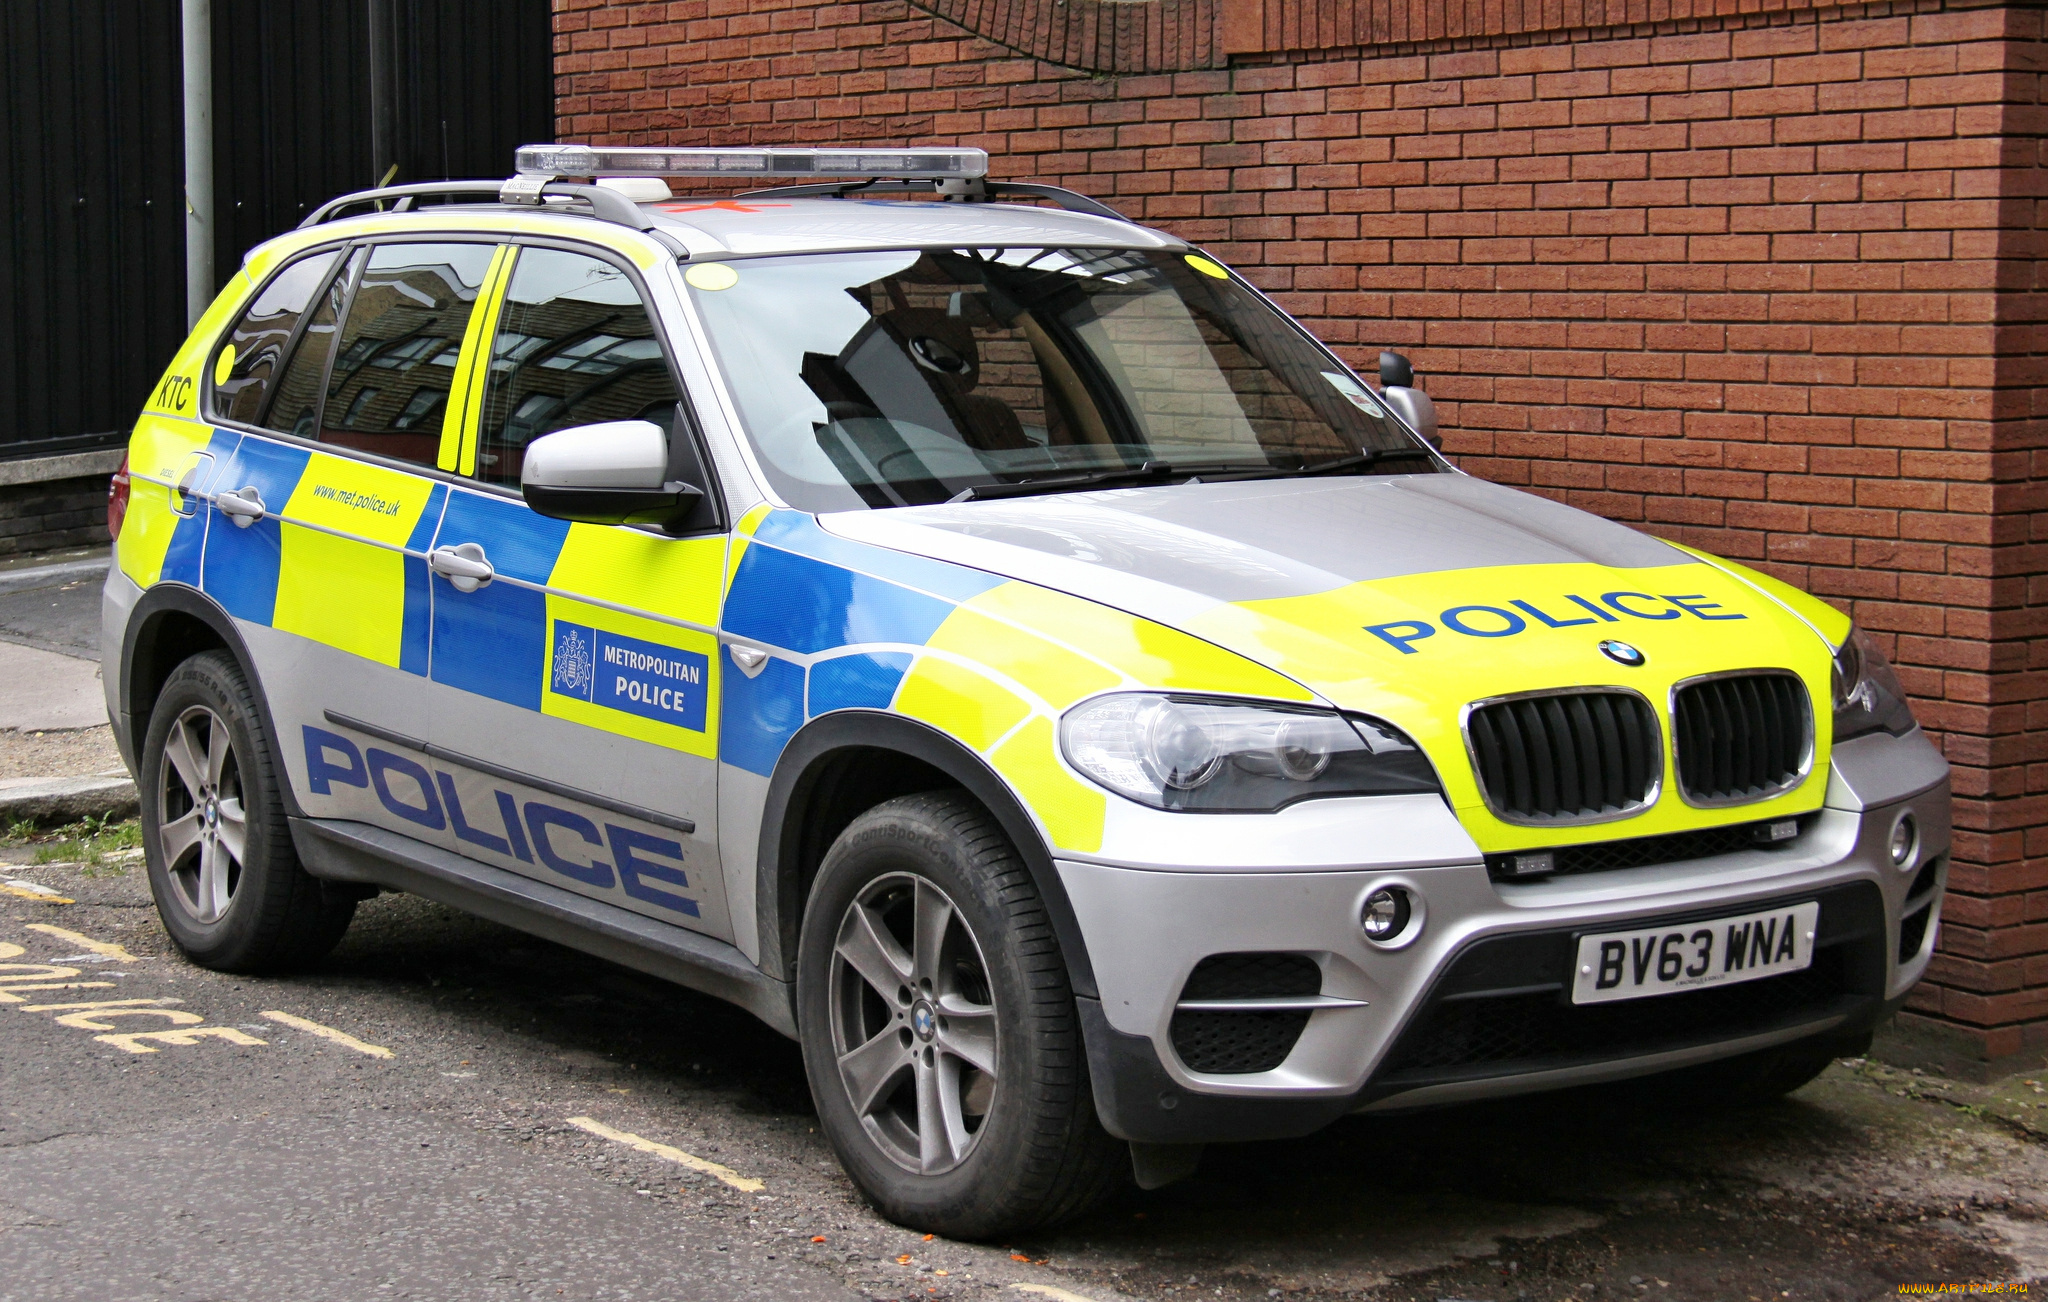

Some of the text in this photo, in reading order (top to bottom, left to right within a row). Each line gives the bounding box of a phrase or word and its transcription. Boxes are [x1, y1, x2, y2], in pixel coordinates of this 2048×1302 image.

[156, 375, 191, 411] KTC
[313, 484, 401, 517] www.met.police.uk
[1361, 591, 1749, 655] POLICE
[604, 644, 699, 685] METROPOLITAN
[615, 676, 684, 712] POLICE
[302, 724, 701, 919] POLICE
[1595, 914, 1795, 990] BV63 WNA
[0, 941, 269, 1054] OLICE
